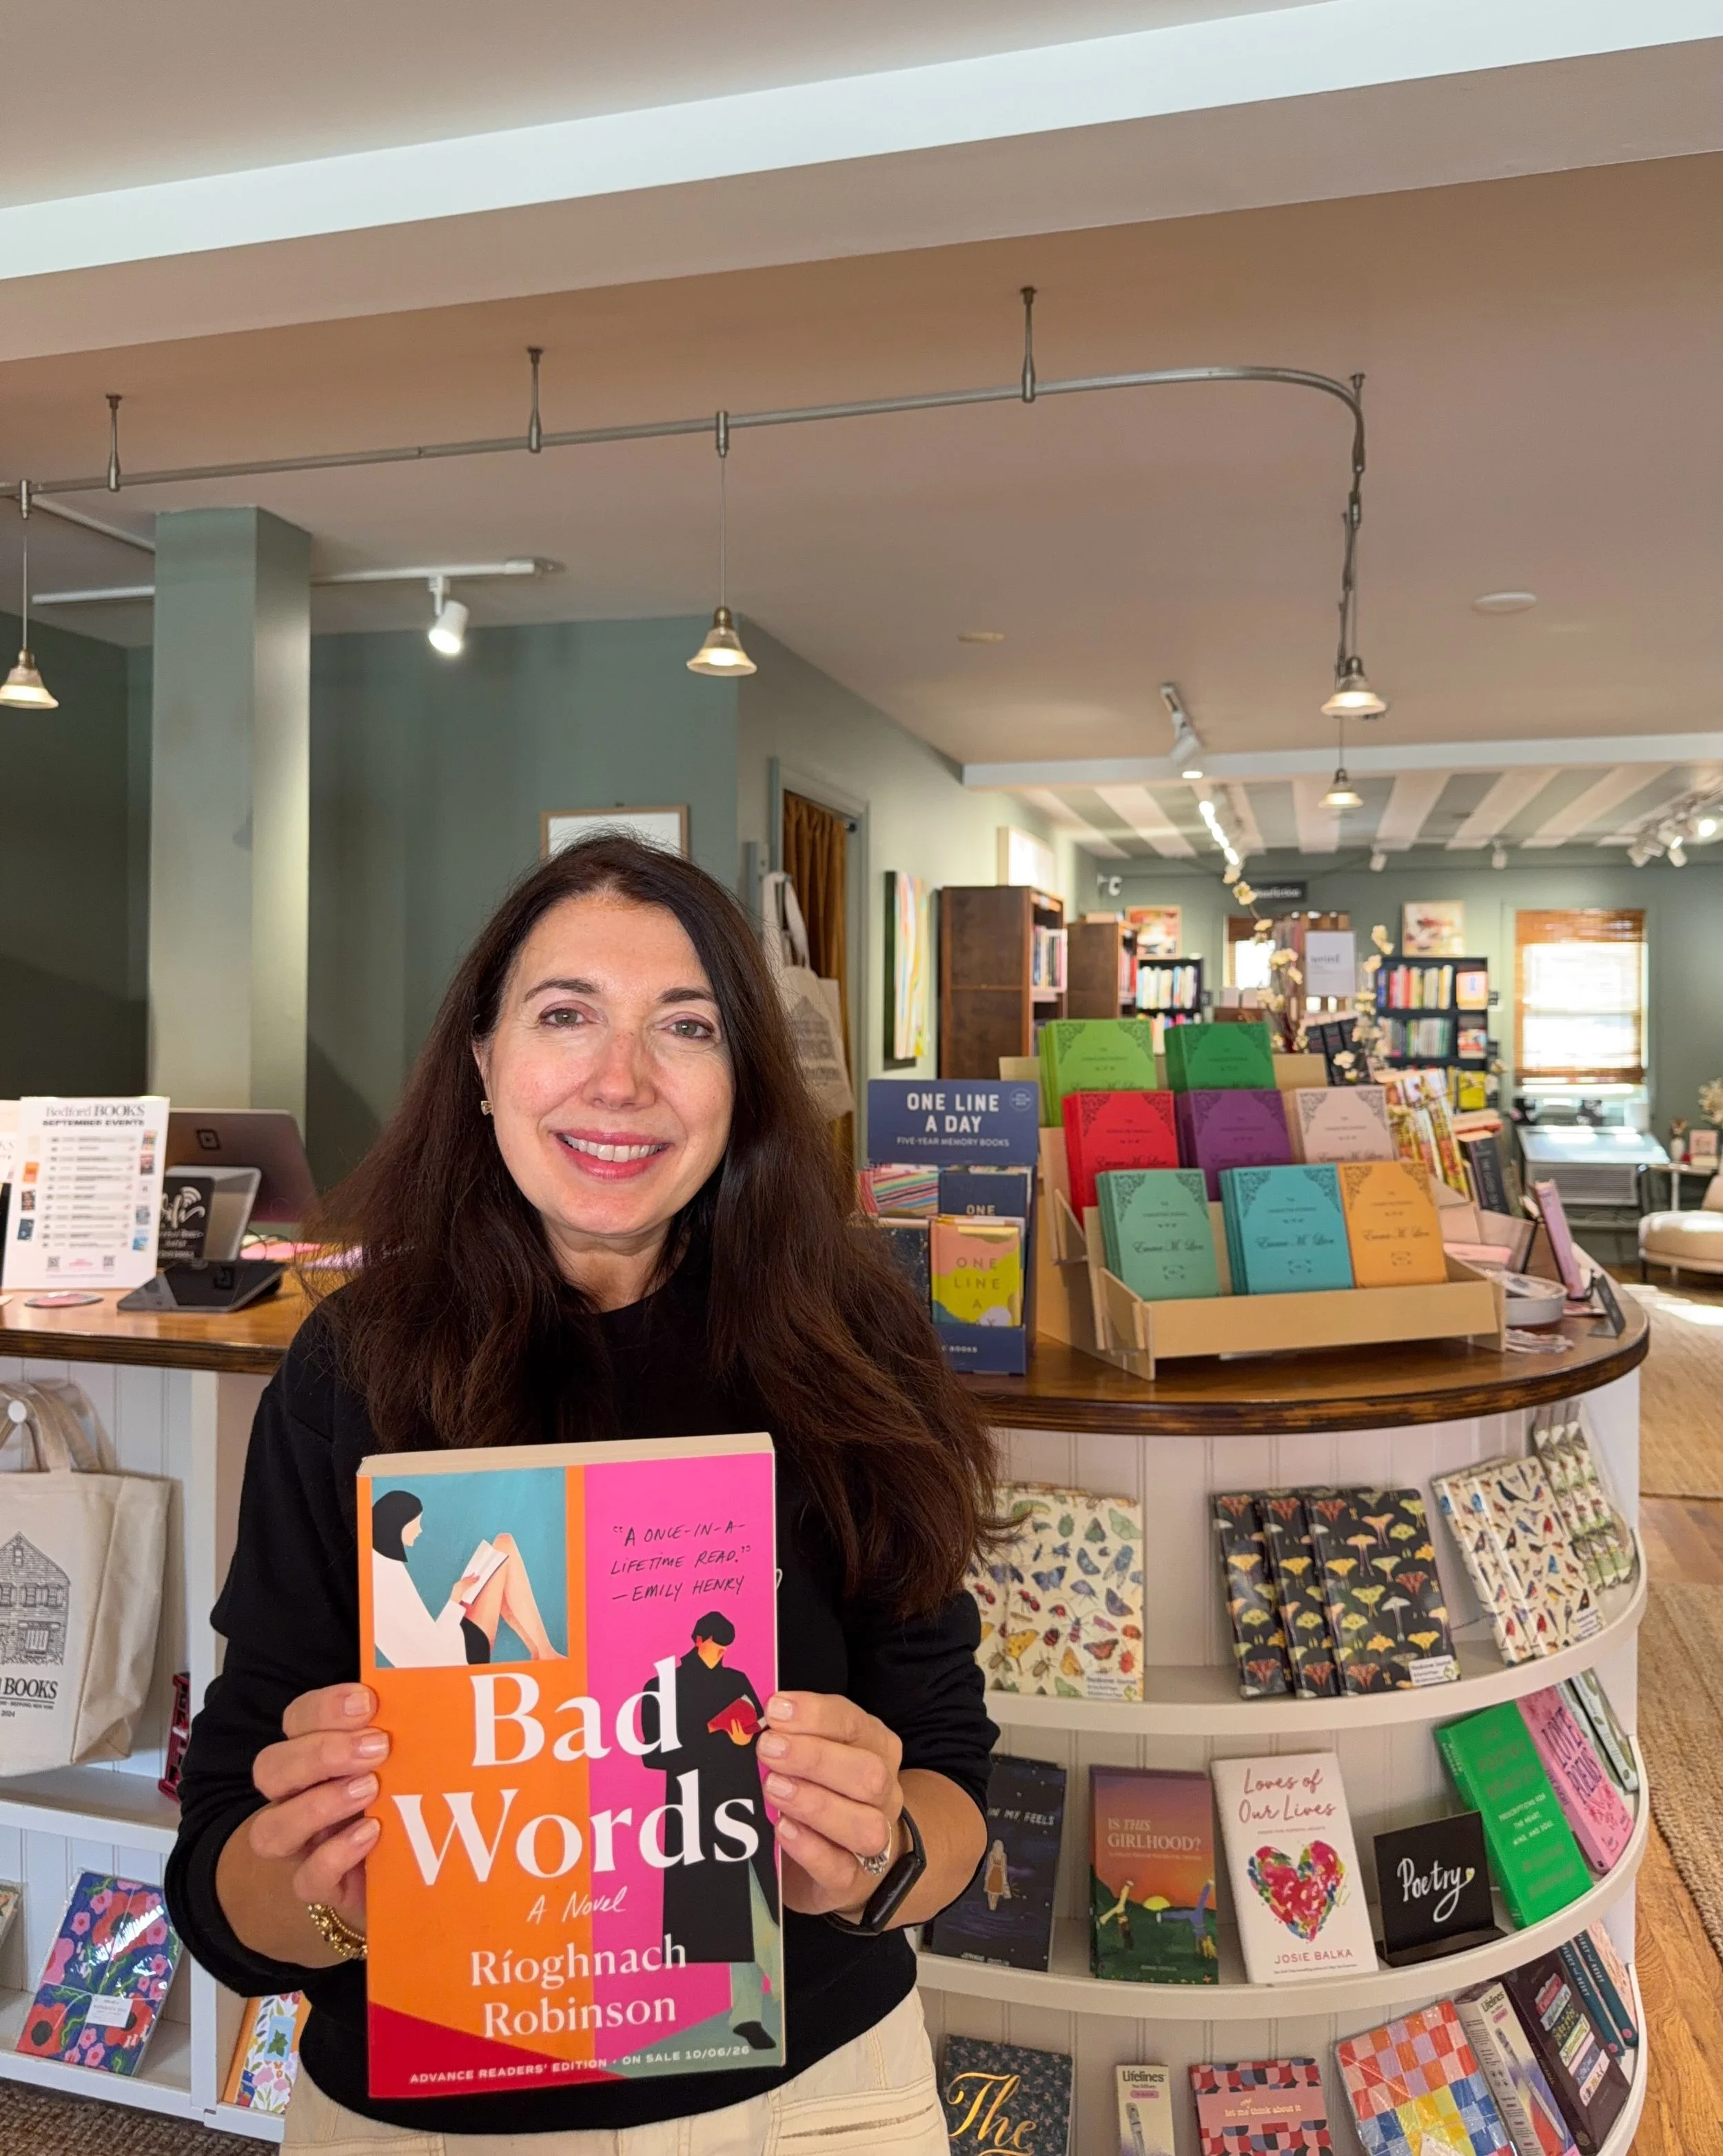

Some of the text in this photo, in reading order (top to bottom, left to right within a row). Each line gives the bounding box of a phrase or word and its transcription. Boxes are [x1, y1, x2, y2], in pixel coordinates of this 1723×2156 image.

[46, 1104, 145, 1117] Bedford BOOKS
[907, 1092, 946, 1111] ONE
[955, 1094, 999, 1112] LINE
[925, 1115, 981, 1134] A DAY
[897, 1137, 1009, 1148] FIVE-YEAR MEMORY BOOKS
[966, 1204, 995, 1215] ONE
[956, 1257, 997, 1270] ONE
[954, 1278, 1000, 1290] LINE
[972, 1299, 982, 1310] A
[692, 1575, 744, 1595] HENRY
[3, 1677, 59, 1700] BOOKS
[470, 1656, 682, 1767] Bad
[1244, 1768, 1323, 1794] Loves of
[1003, 1809, 1021, 1820] MY
[1024, 1811, 1054, 1825] FEELS
[1238, 1795, 1336, 1823] Our Lives
[391, 1768, 759, 1886] Words
[1108, 1818, 1152, 1831] IS THIS
[1108, 1833, 1201, 1851] GIRLHOOD?
[1397, 1858, 1469, 1922] Poetry
[527, 1886, 628, 1924] A Novel
[471, 1934, 686, 1989] Ríoghnach
[1274, 1949, 1353, 1964] JOSIE BALKA
[484, 1996, 676, 2038] Robinson
[410, 2070, 473, 2084] ADVANCE
[552, 2059, 607, 2072] EDITION
[622, 2056, 641, 2065] ON
[646, 2053, 680, 2064] SALE
[685, 2045, 750, 2060] 10/06/26
[1122, 2071, 1165, 2082] Lifelines
[946, 2072, 1037, 2150] The
[1272, 2105, 1294, 2113] about
